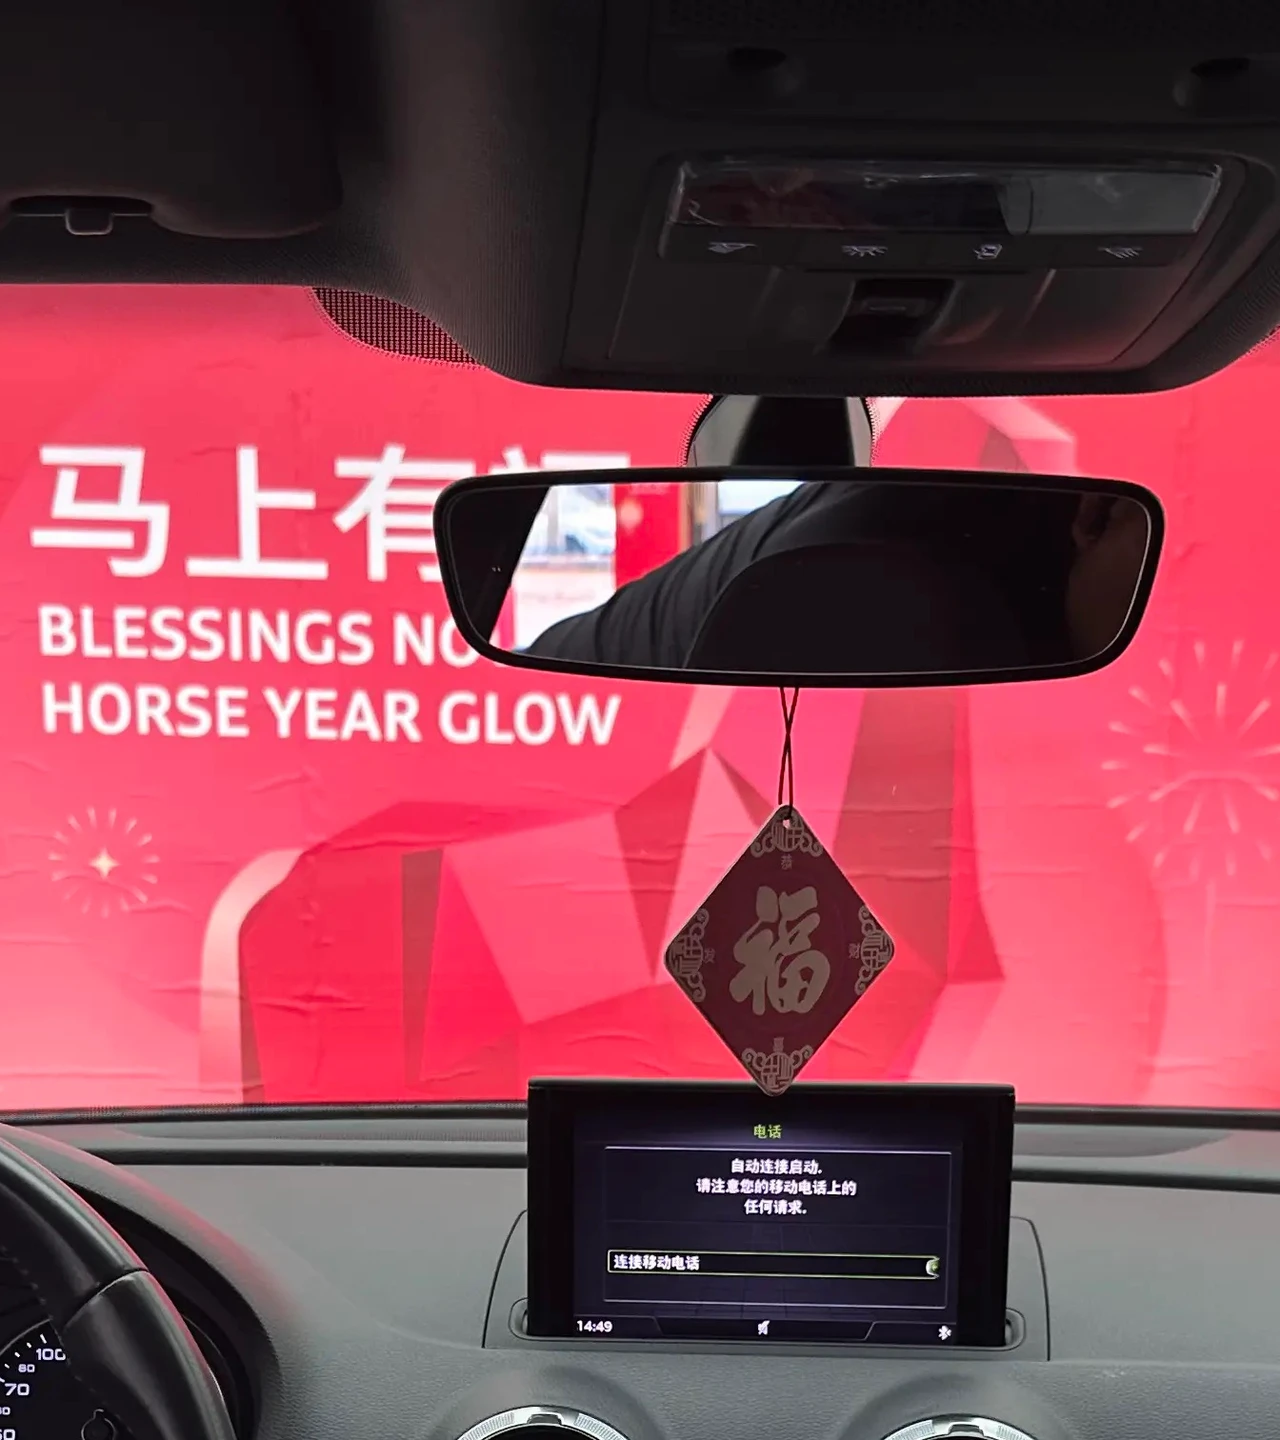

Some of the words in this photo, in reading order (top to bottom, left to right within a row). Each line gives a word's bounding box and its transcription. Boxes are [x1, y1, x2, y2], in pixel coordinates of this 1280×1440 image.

[30, 443, 631, 582] 马上有
[37, 604, 374, 667] BLESSINGS
[393, 612, 506, 668] NO
[41, 682, 250, 738] HORSE
[264, 687, 422, 742] YEAR
[437, 691, 622, 746] GLOW
[729, 886, 831, 1016] 福
[753, 1124, 783, 1139] 电话
[696, 1178, 857, 1196] 请注意您的移动电话上的
[613, 1254, 700, 1271] 连接移动电话
[576, 1319, 613, 1333] 14:49
[36, 1348, 66, 1361] 100
[18, 1364, 35, 1373] 80
[4, 1383, 30, 1396] 70
